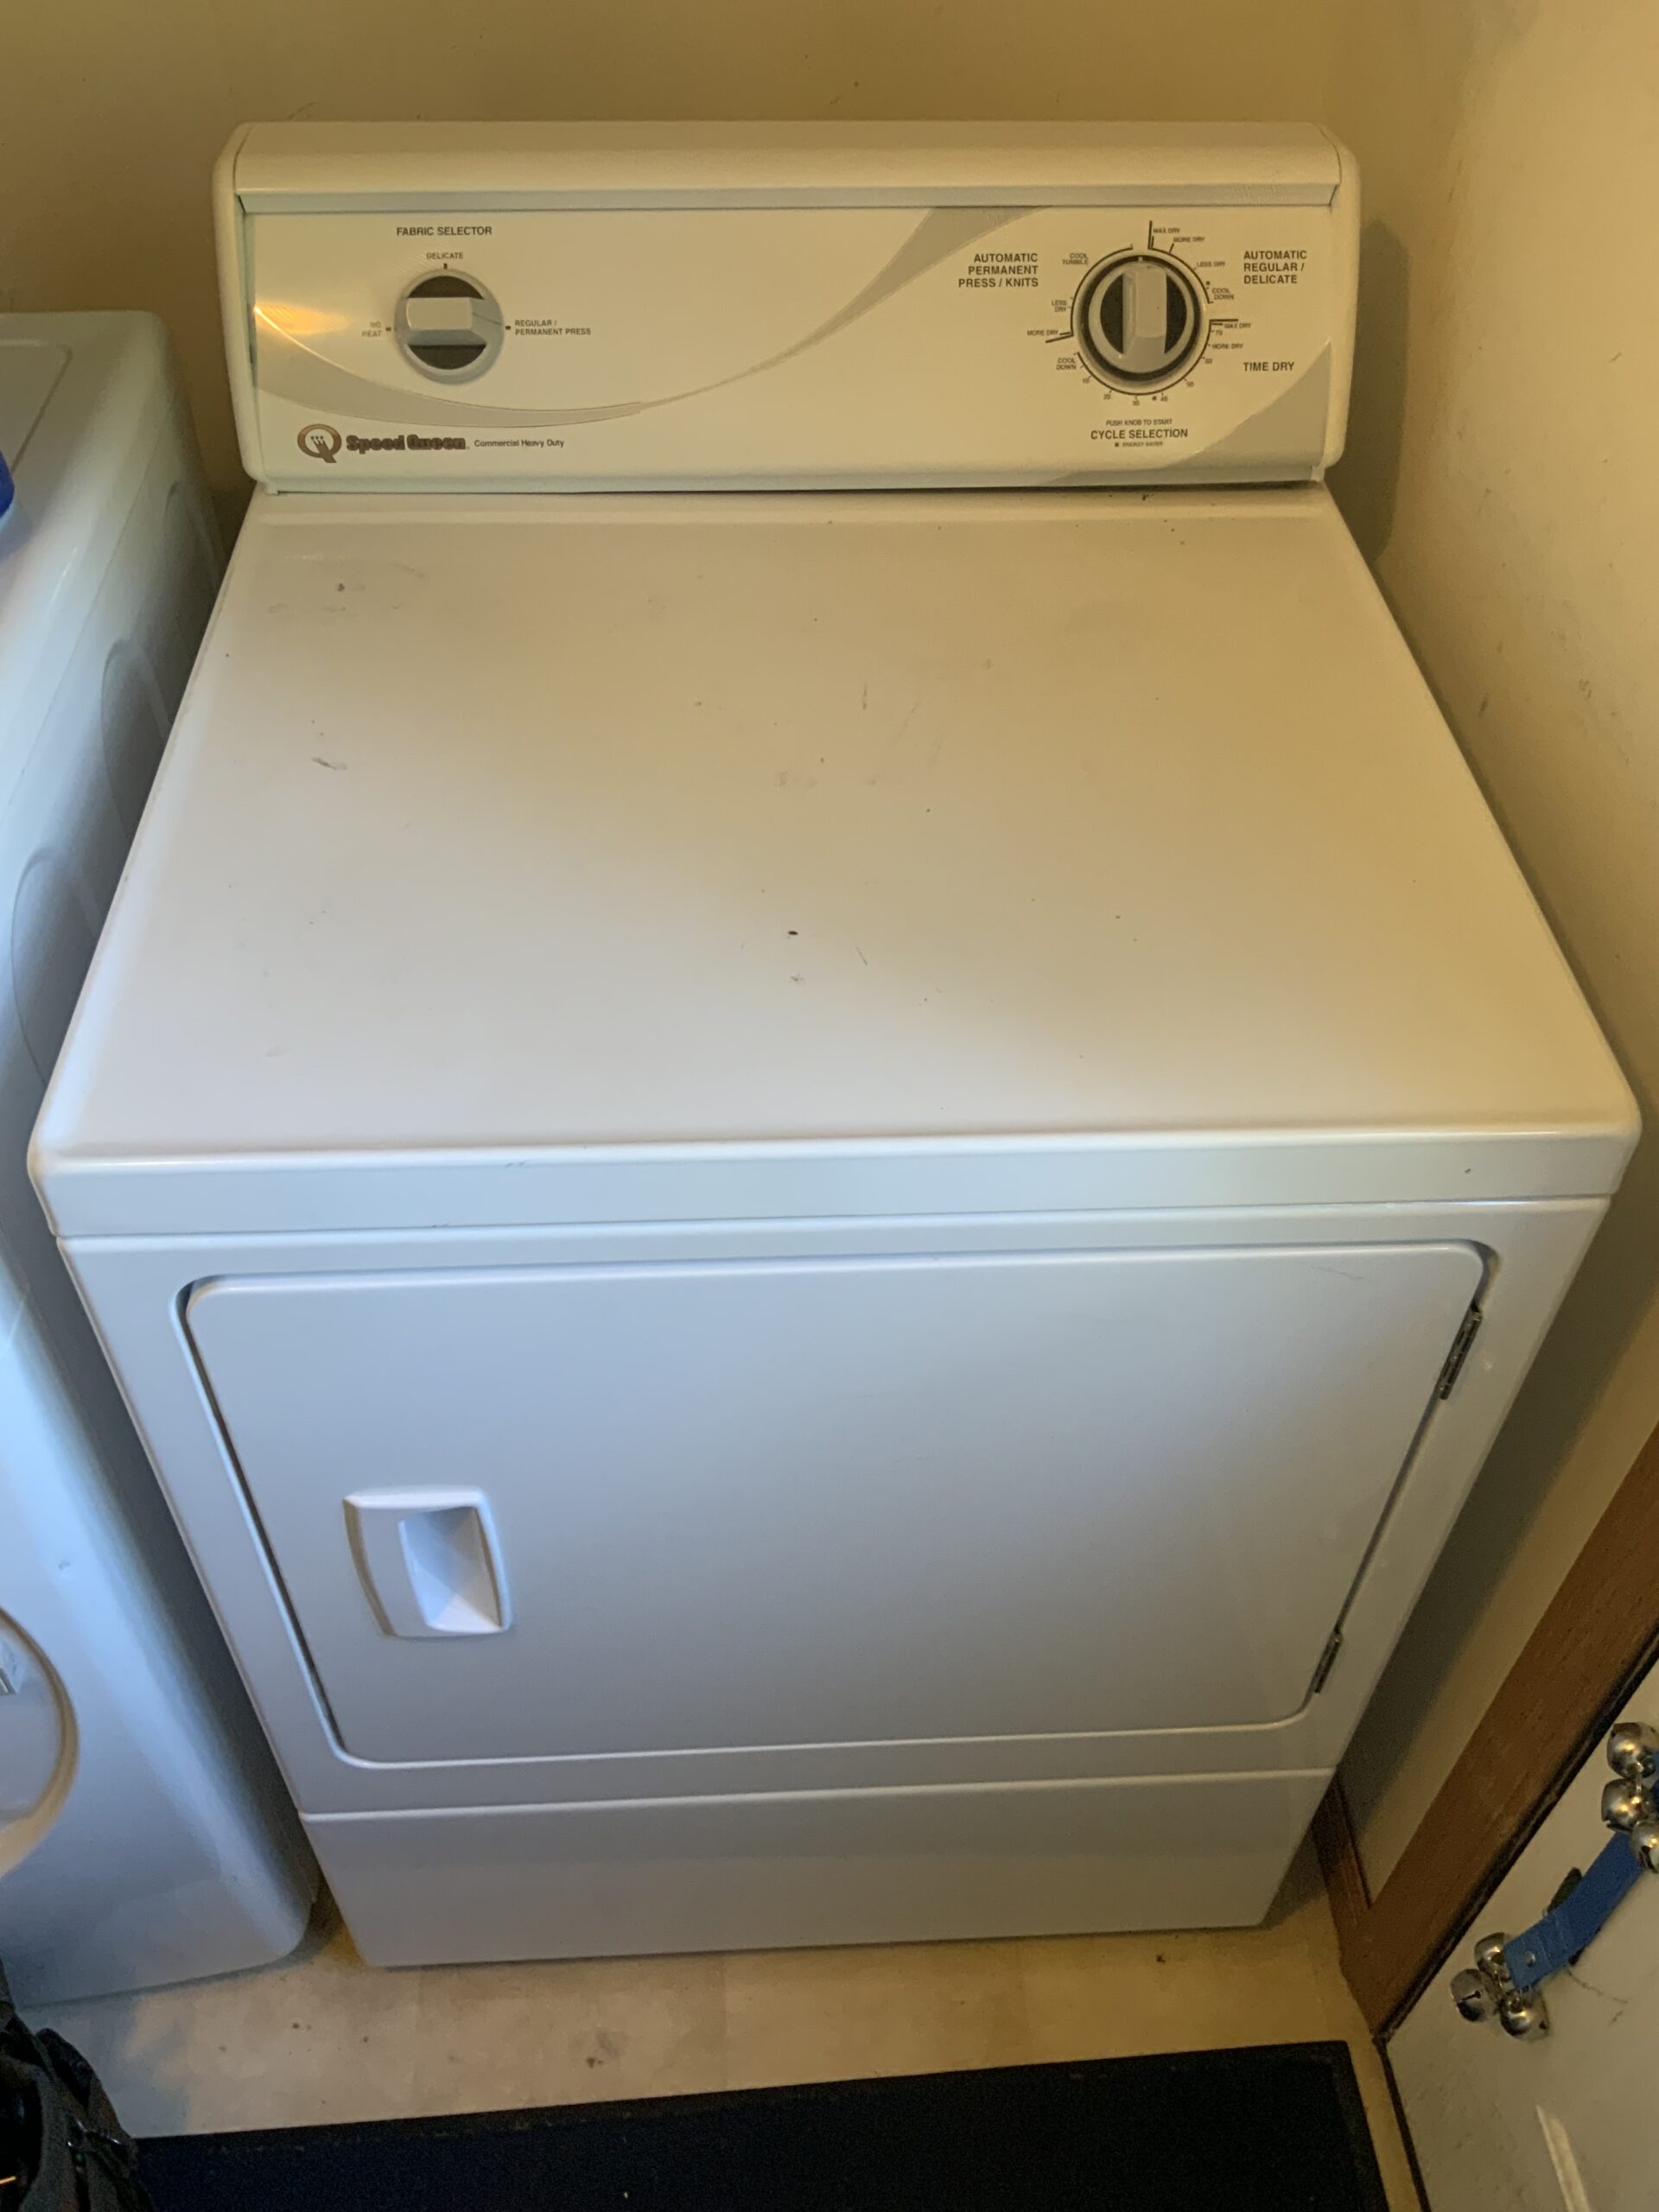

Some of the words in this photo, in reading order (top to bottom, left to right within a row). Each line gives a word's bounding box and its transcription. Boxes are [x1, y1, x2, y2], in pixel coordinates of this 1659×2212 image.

[397, 226, 434, 236] FABRIC
[437, 226, 492, 236] SELECTOR
[974, 253, 1038, 263] AUTOMATIC
[1244, 250, 1307, 260] AUTOMATIC
[968, 265, 1039, 276] PERMANENT
[1244, 263, 1298, 272] REGULAR
[958, 277, 996, 288] PRESS
[1005, 277, 1039, 288] KNITS
[1244, 275, 1298, 284] DELICATE
[566, 327, 591, 336] PRESS
[1243, 362, 1268, 372] TIME
[1272, 361, 1294, 372] DRY
[1090, 429, 1125, 440] CYCLE
[1128, 429, 1188, 439] SELECTION
[346, 435, 405, 454] Speed
[407, 434, 467, 450] Queen
[474, 439, 518, 448] Commercial
[521, 439, 544, 448] Heavy
[547, 439, 564, 448] Duty
